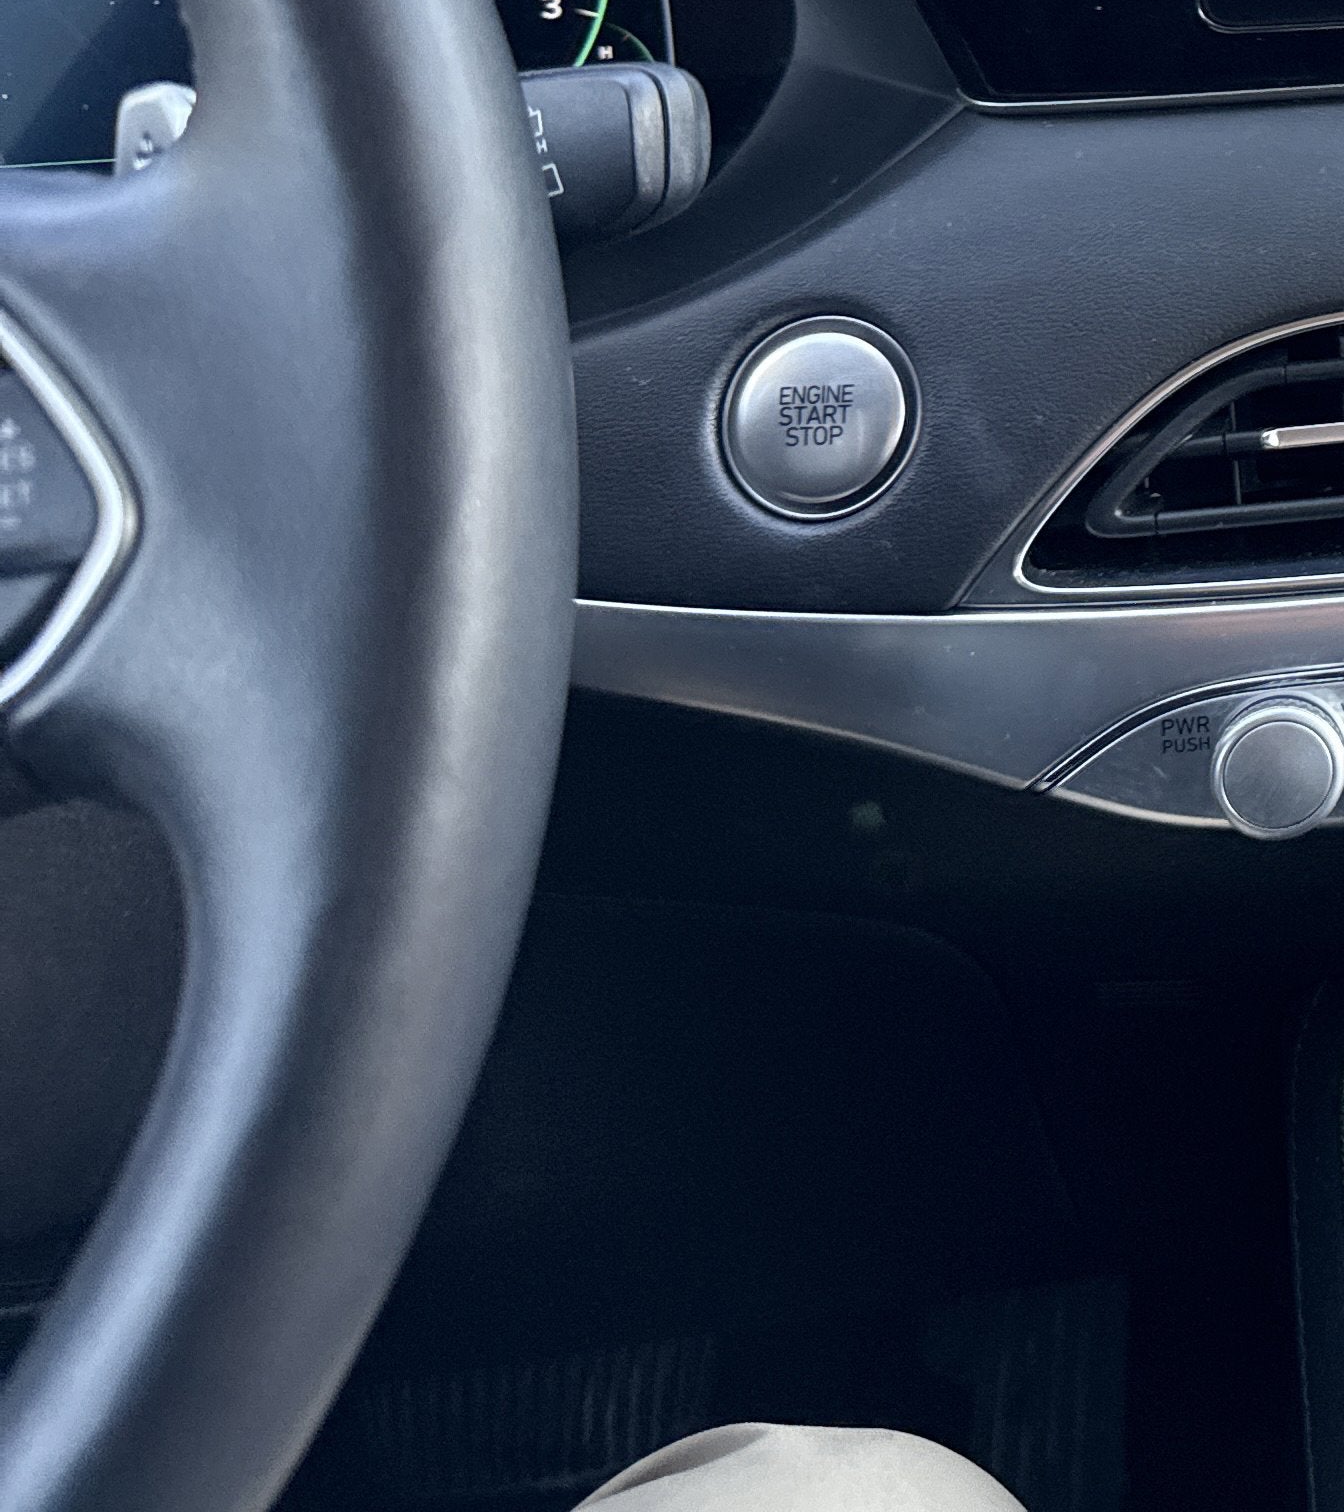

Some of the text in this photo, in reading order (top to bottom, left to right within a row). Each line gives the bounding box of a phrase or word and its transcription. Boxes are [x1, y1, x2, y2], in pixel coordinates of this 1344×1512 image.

[597, 45, 613, 59] H
[779, 384, 855, 405] ENGINE
[779, 405, 852, 426] START
[786, 426, 844, 447] STOP
[1161, 715, 1211, 736] PWR
[1162, 737, 1211, 754] PUSH
